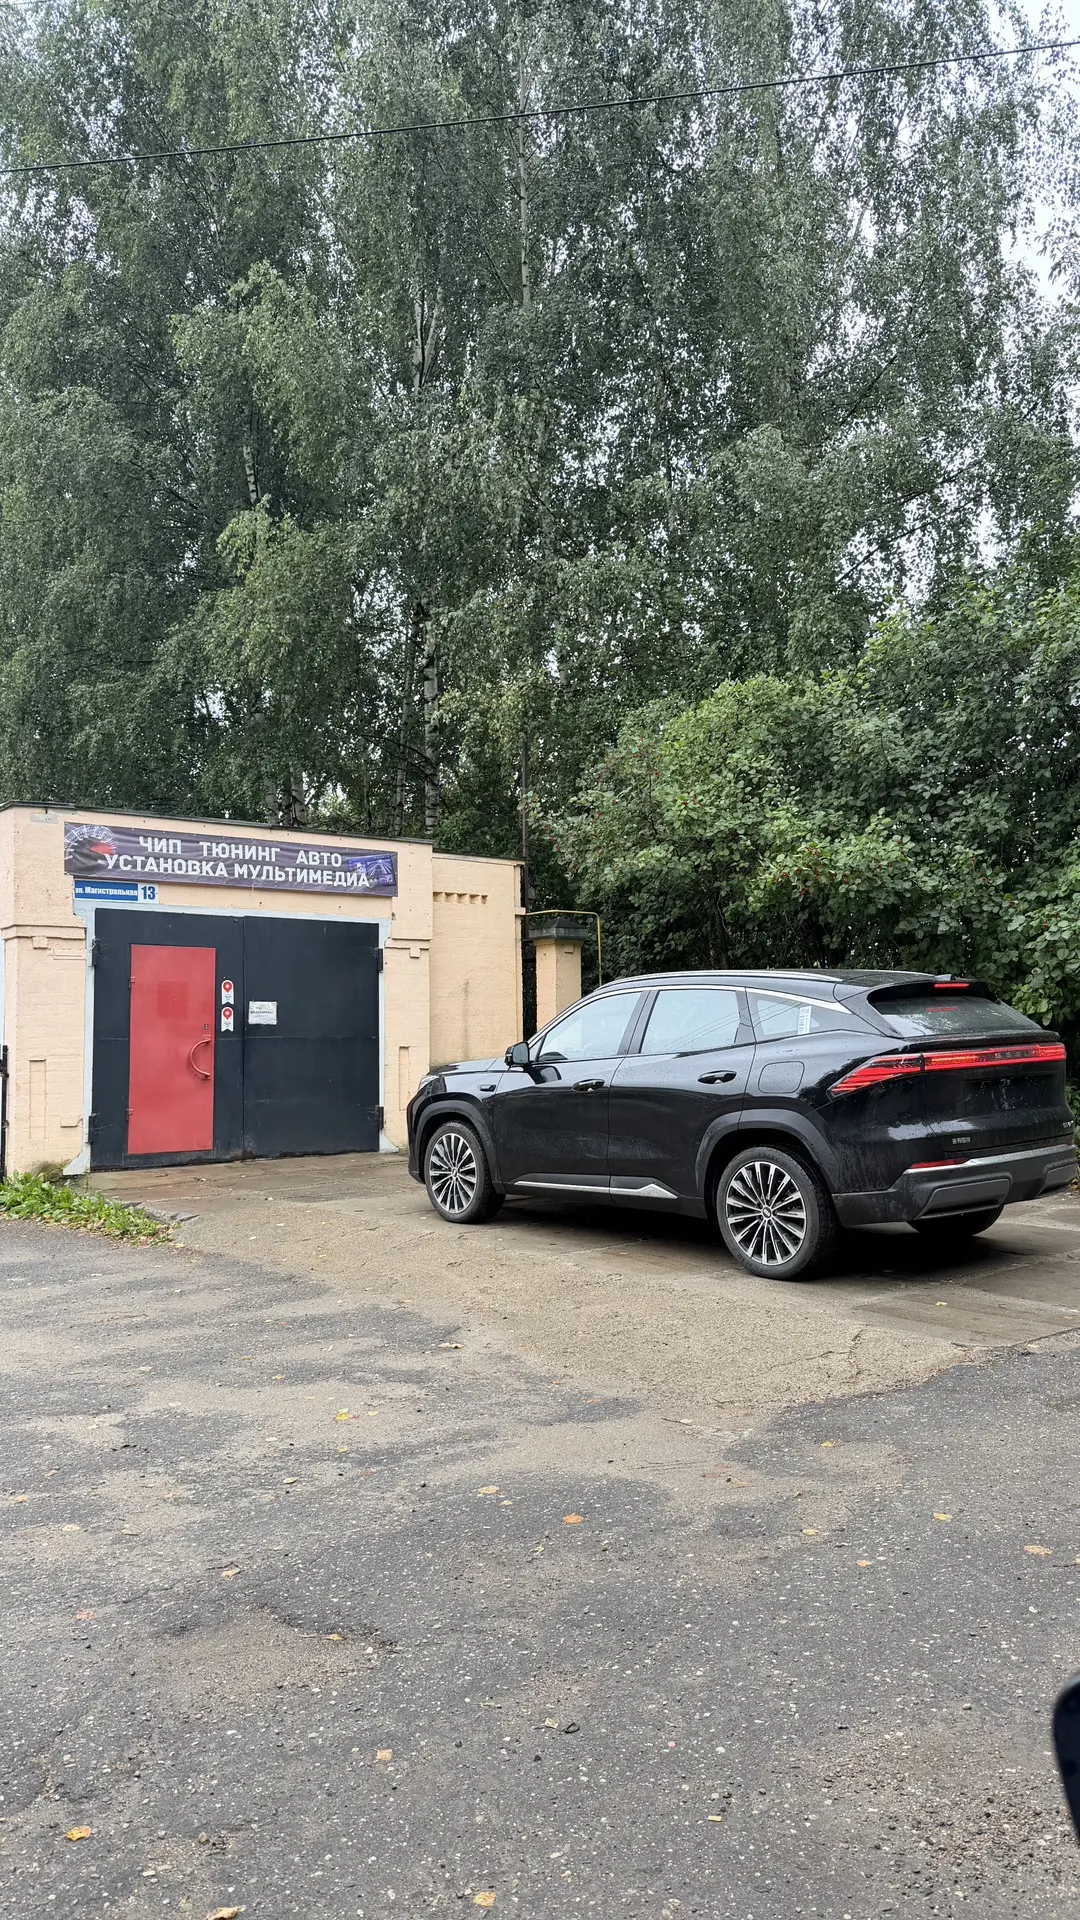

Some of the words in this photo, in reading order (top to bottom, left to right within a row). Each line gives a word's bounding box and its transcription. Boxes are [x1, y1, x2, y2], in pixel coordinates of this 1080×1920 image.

[138, 836, 182, 855] ЧИП
[199, 841, 281, 863] ТЮНИНГ
[296, 850, 342, 867] АВТО
[104, 853, 228, 878] УСТАНОВКА
[234, 863, 370, 887] МУЛЬТИМЕДИА
[75, 887, 84, 895] ул.
[85, 886, 138, 896] Магистральная
[141, 885, 156, 900] 13
